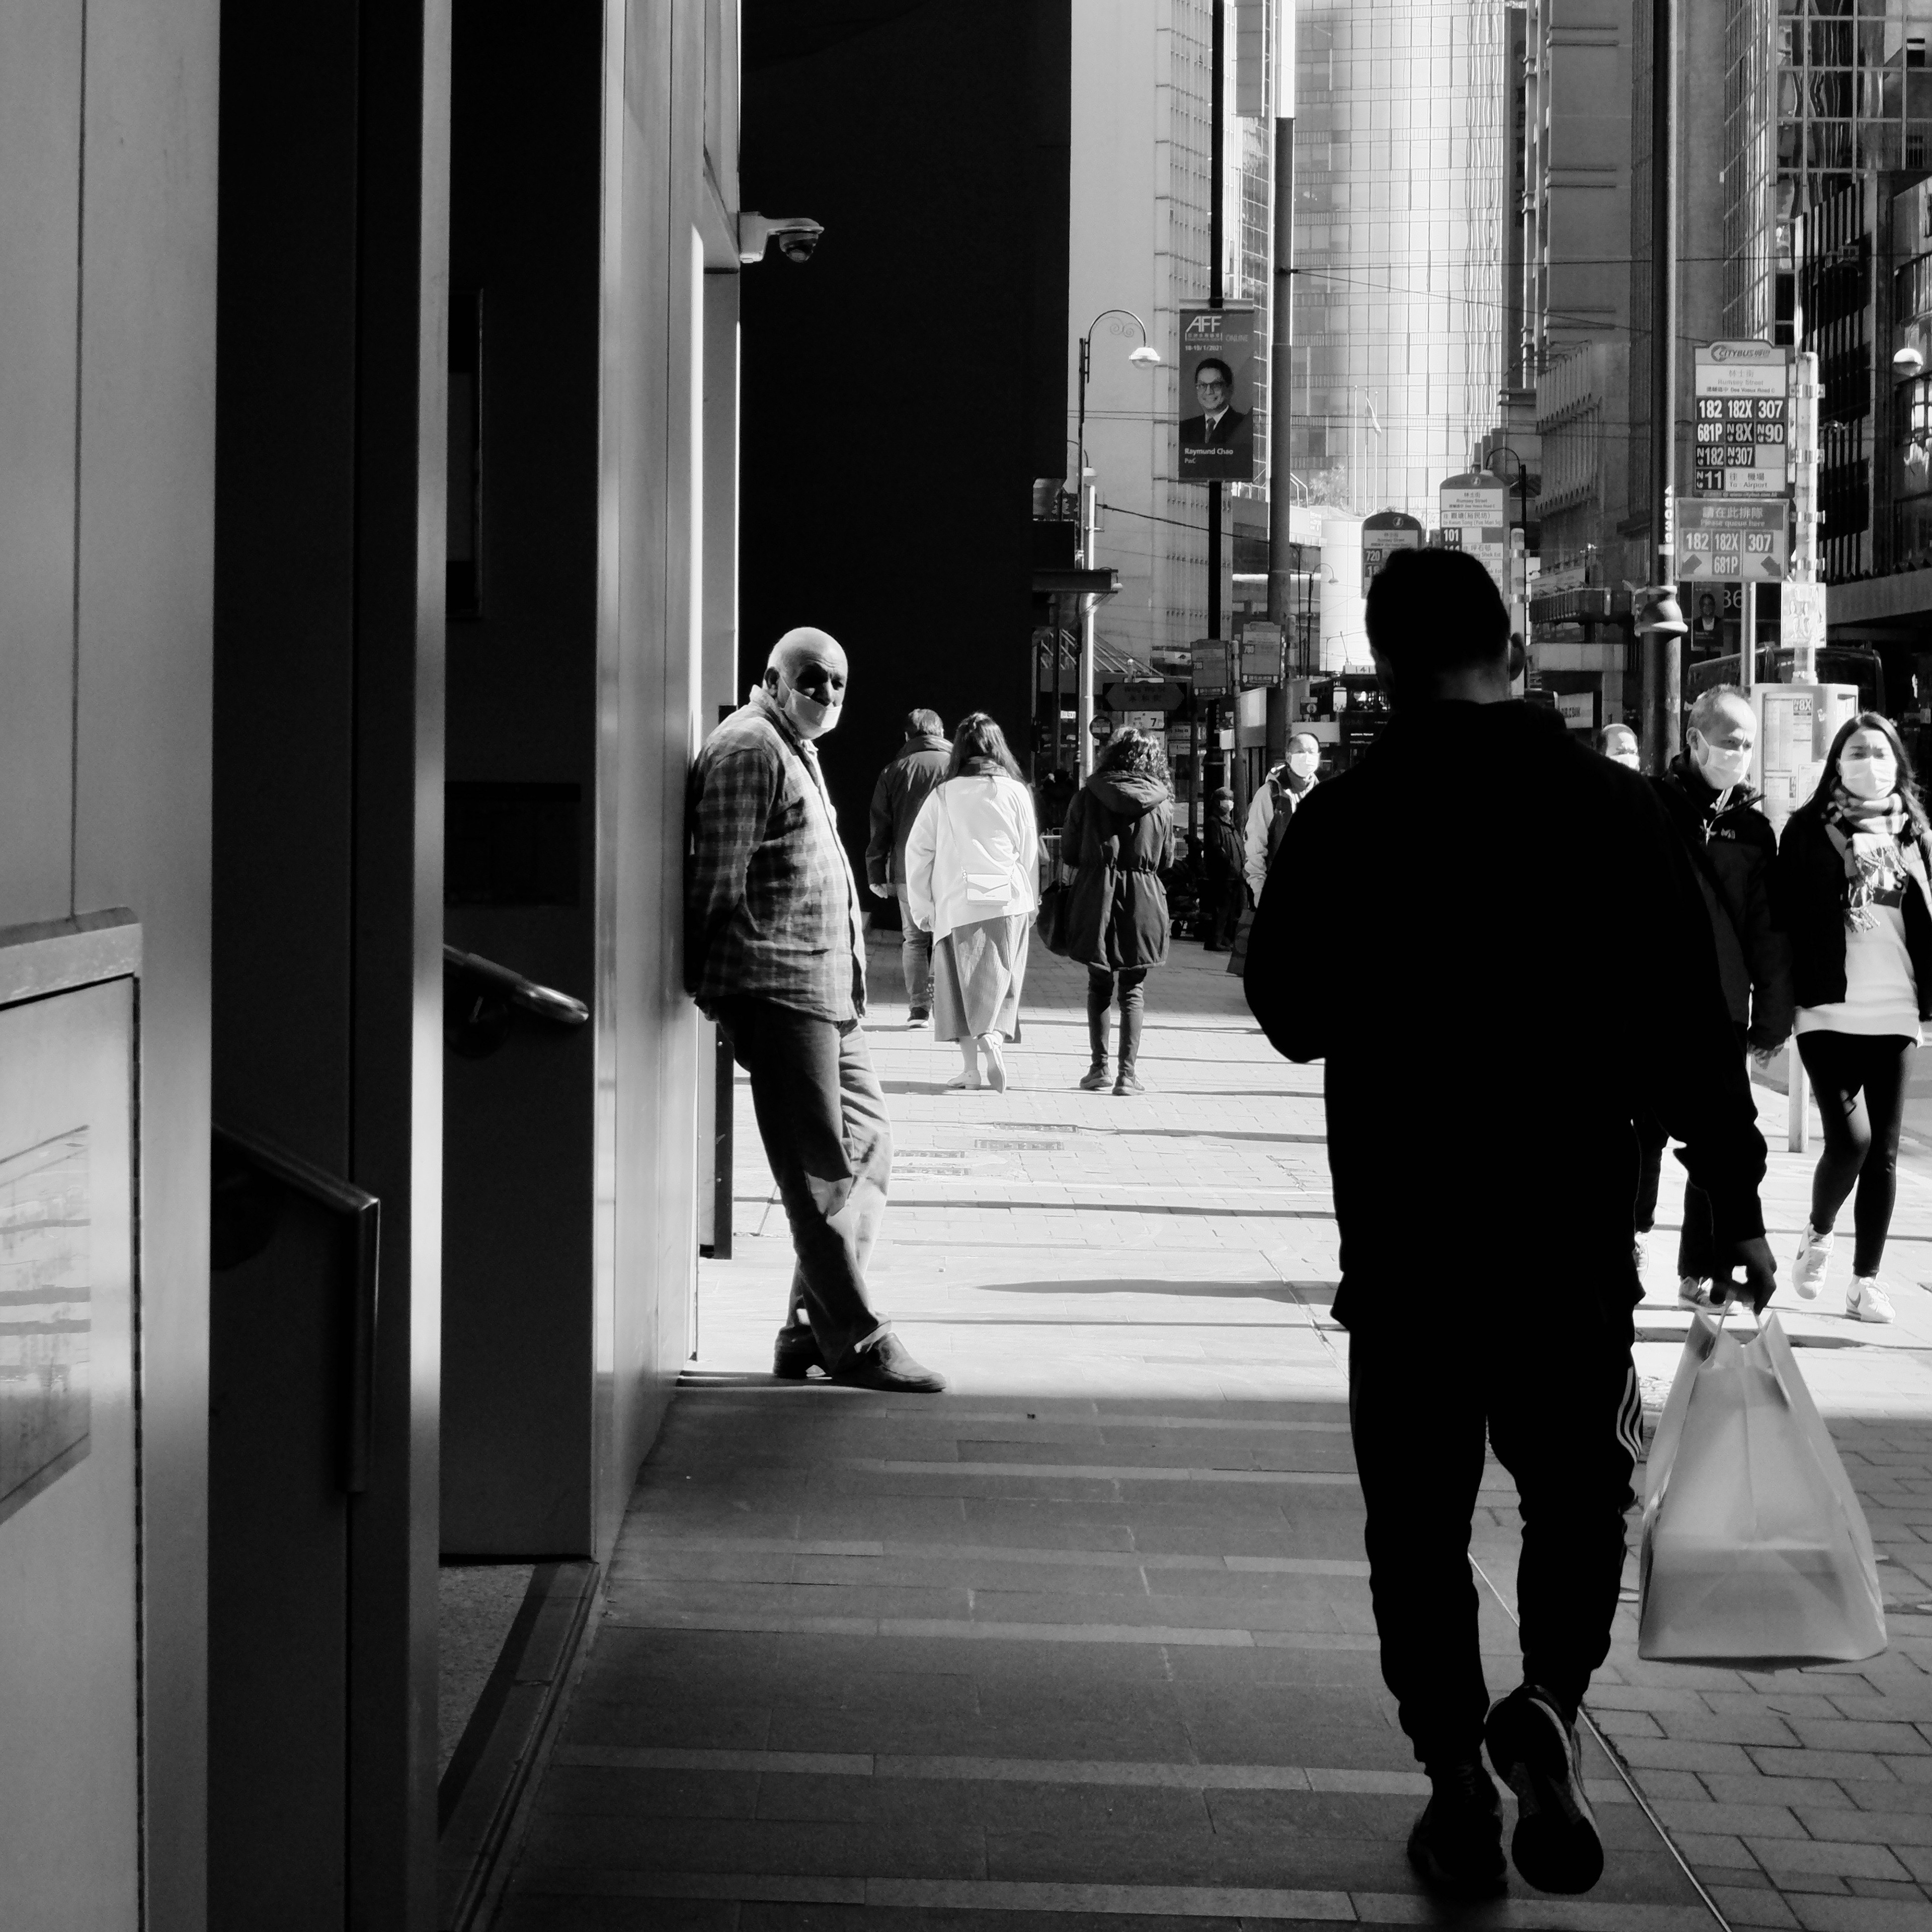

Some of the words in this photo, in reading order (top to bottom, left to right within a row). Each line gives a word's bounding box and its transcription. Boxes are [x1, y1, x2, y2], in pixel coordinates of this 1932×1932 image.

[1185, 315, 1222, 333] AFF
[1699, 399, 1723, 419] 182
[1728, 399, 1753, 419] 182X
[1758, 399, 1783, 419] 307
[1697, 423, 1723, 442] 681P
[1184, 447, 1216, 456] Raymund
[1700, 519, 1723, 527] Please
[1443, 529, 1459, 542] 101
[1686, 533, 1709, 550] 182
[1715, 533, 1738, 550] 182X
[1748, 533, 1771, 551] 307
[1366, 550, 1381, 561] 720
[1714, 556, 1738, 574] 681P
[1150, 718, 1157, 727] 7
